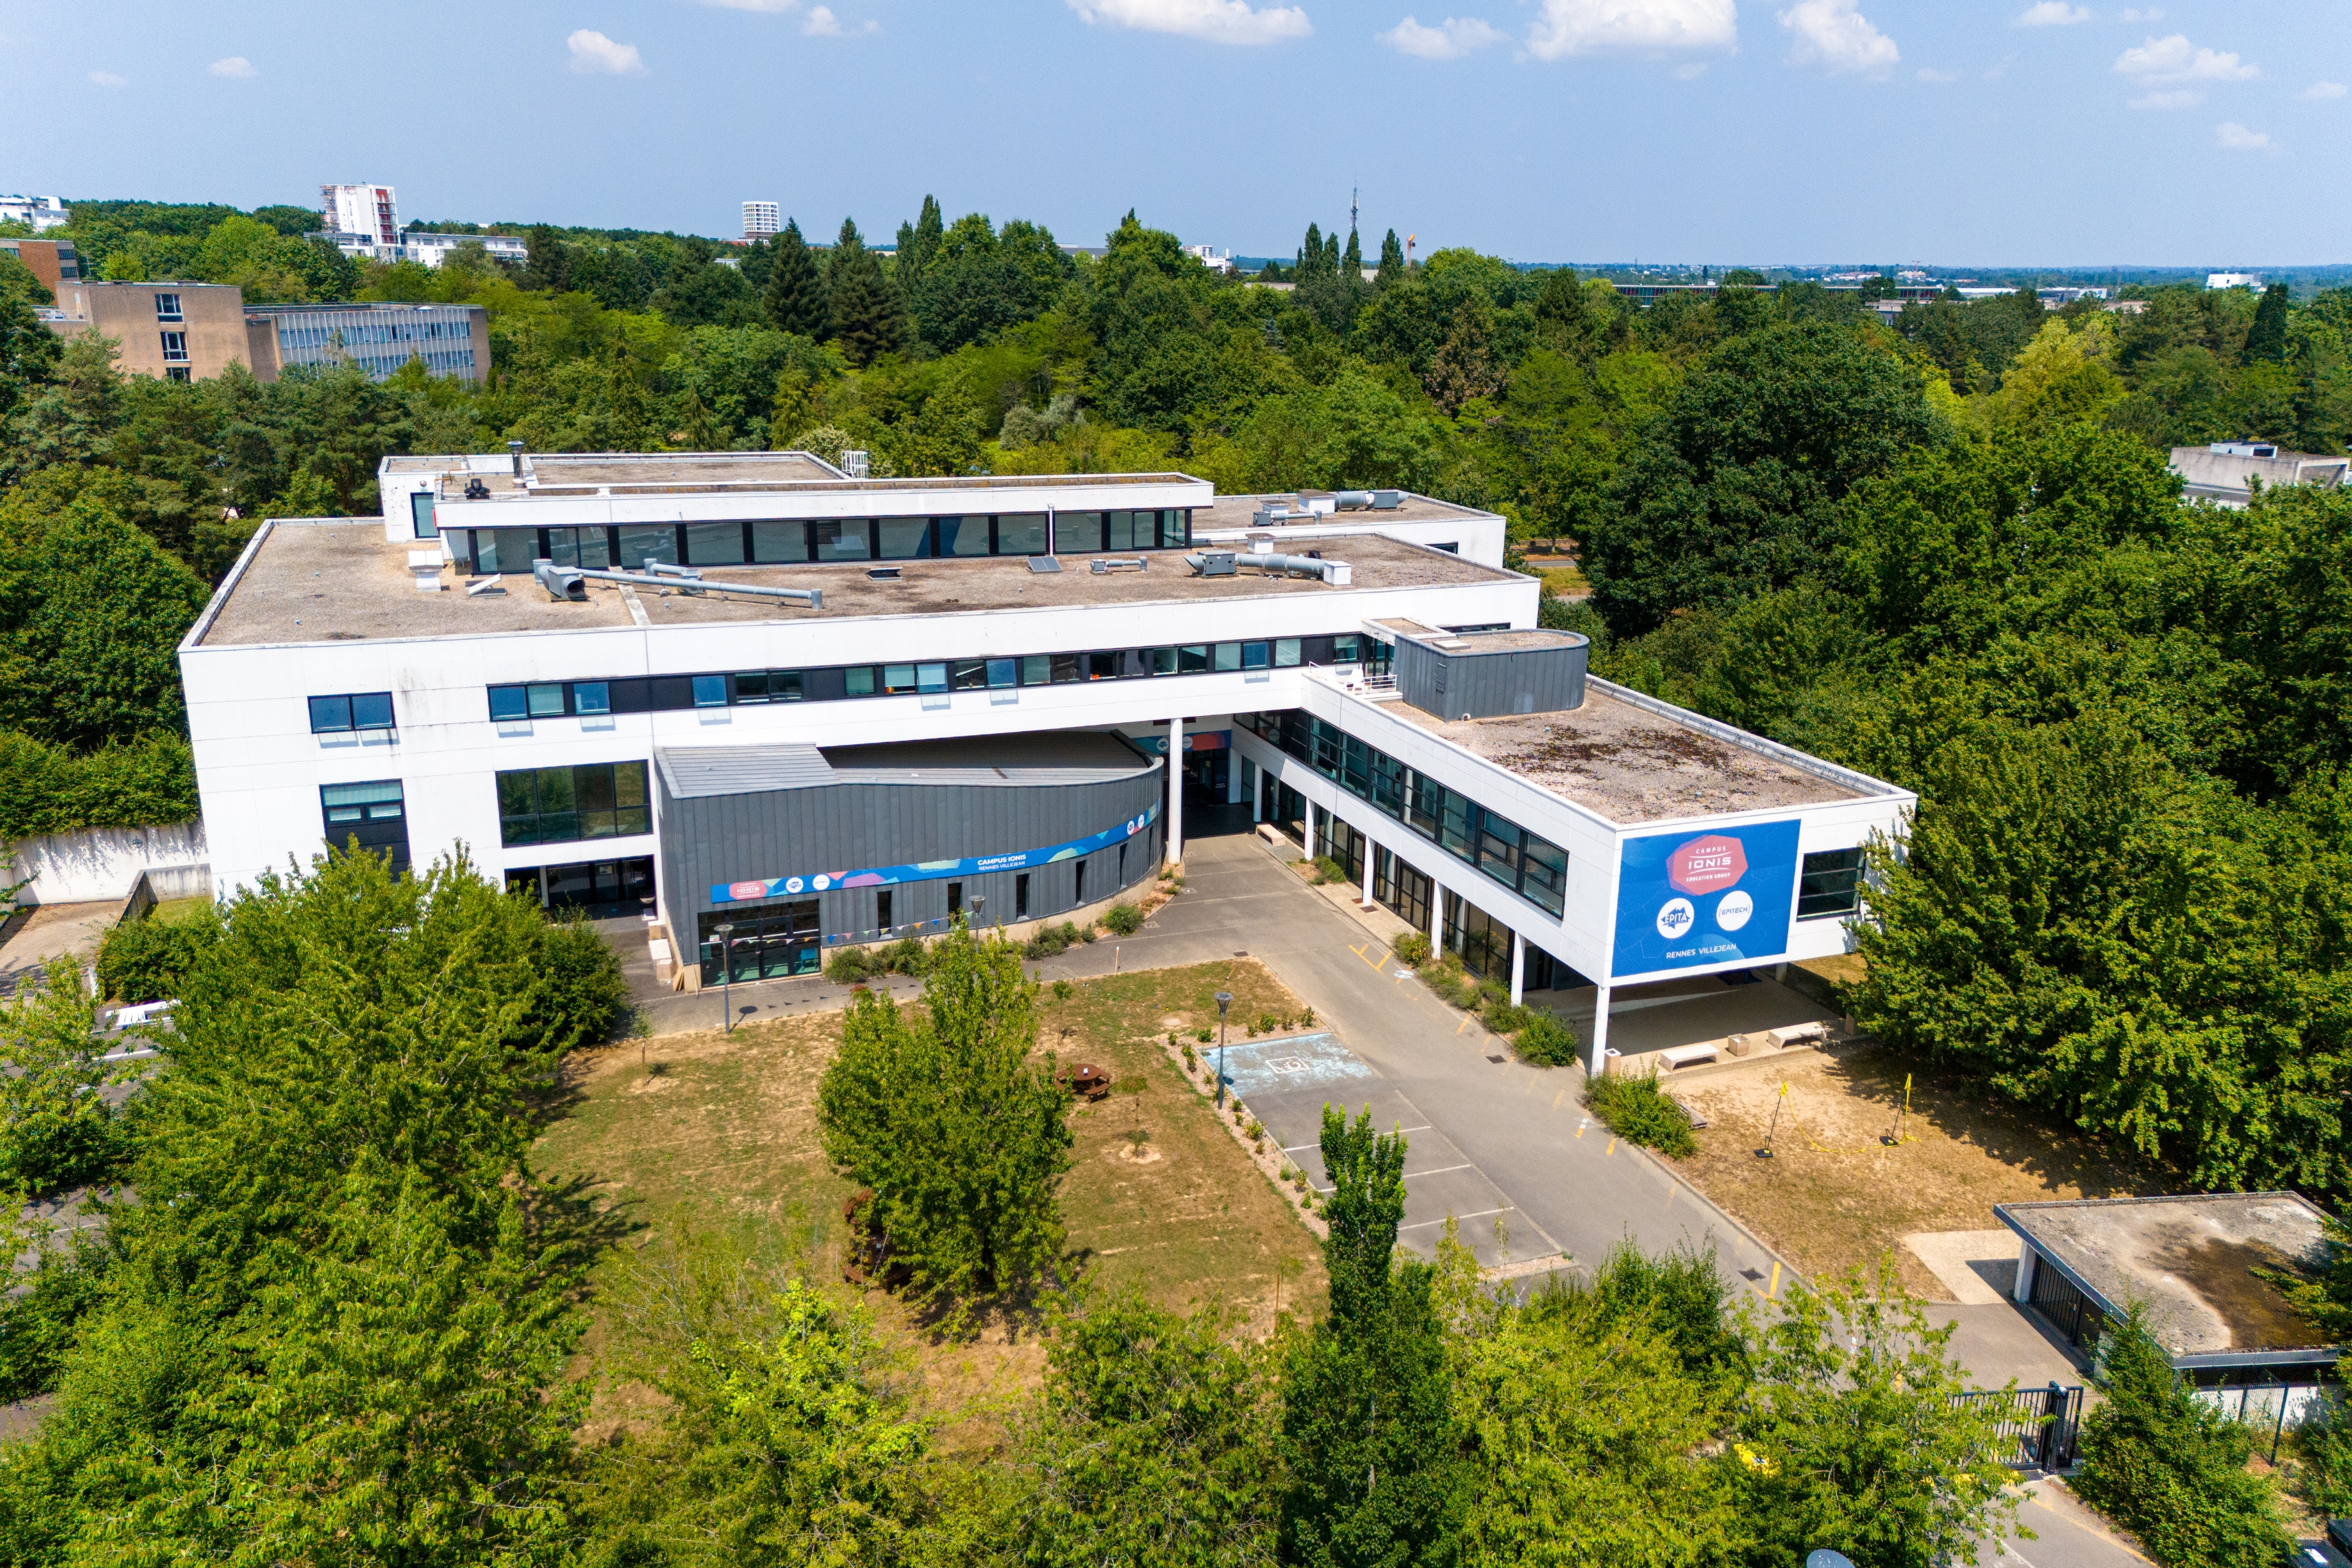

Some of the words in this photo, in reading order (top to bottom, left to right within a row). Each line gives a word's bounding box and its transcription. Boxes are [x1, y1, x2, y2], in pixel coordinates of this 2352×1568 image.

[1696, 846, 1726, 854] CAMPUS
[977, 857, 1007, 865] CAMPUS
[1688, 857, 1731, 869] IONIS
[1664, 912, 1687, 922] EPITA
[1666, 948, 1696, 959] RENNES
[1699, 944, 1736, 954] VILLEJEAN
